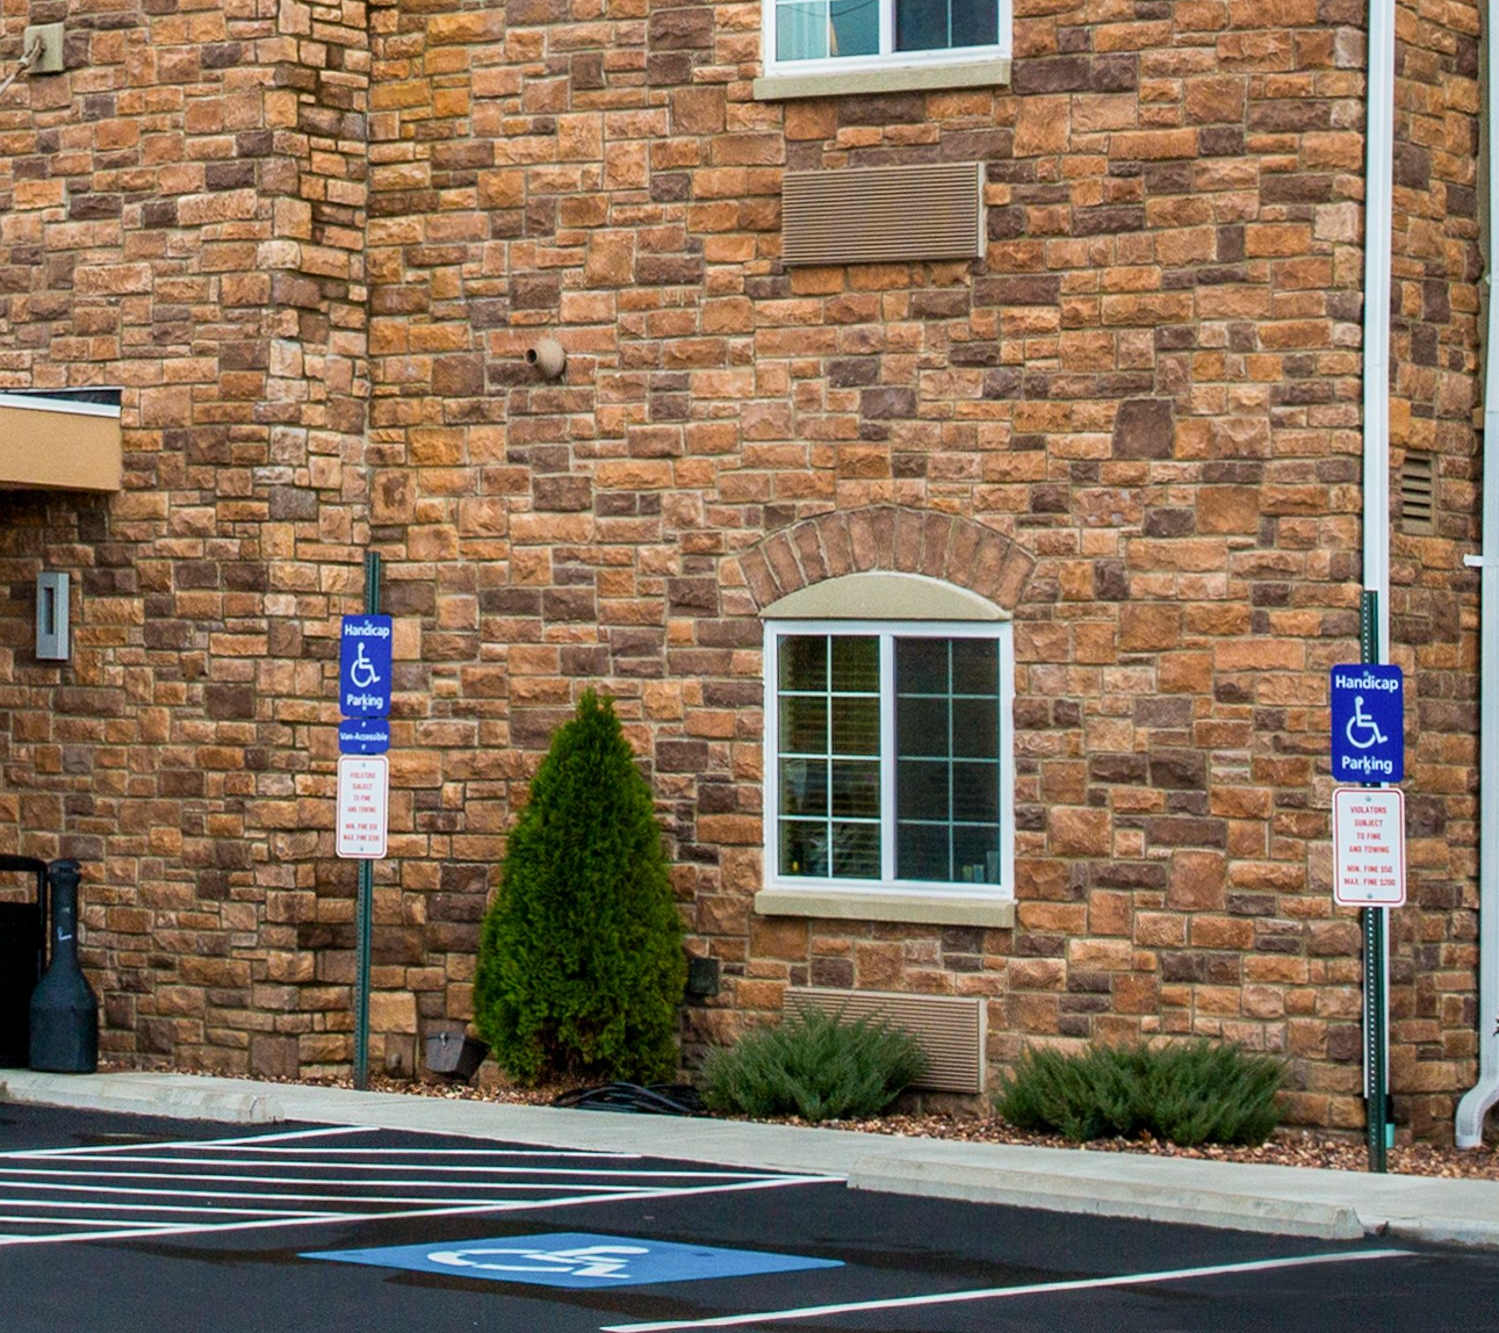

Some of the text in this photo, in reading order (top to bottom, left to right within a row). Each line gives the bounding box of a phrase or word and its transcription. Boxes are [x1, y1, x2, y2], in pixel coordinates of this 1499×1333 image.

[344, 624, 390, 639] Handicap
[1335, 674, 1398, 693] Handicap
[346, 693, 384, 710] Parking
[1342, 756, 1393, 774] Parking
[1350, 806, 1387, 814] VIOLATORS
[1354, 819, 1383, 827] SUBJECT
[1357, 832, 1382, 840] TO FINE
[1349, 845, 1390, 854] AND TOWING
[1364, 865, 1379, 873] FINE
[1363, 878, 1378, 886] FINE
